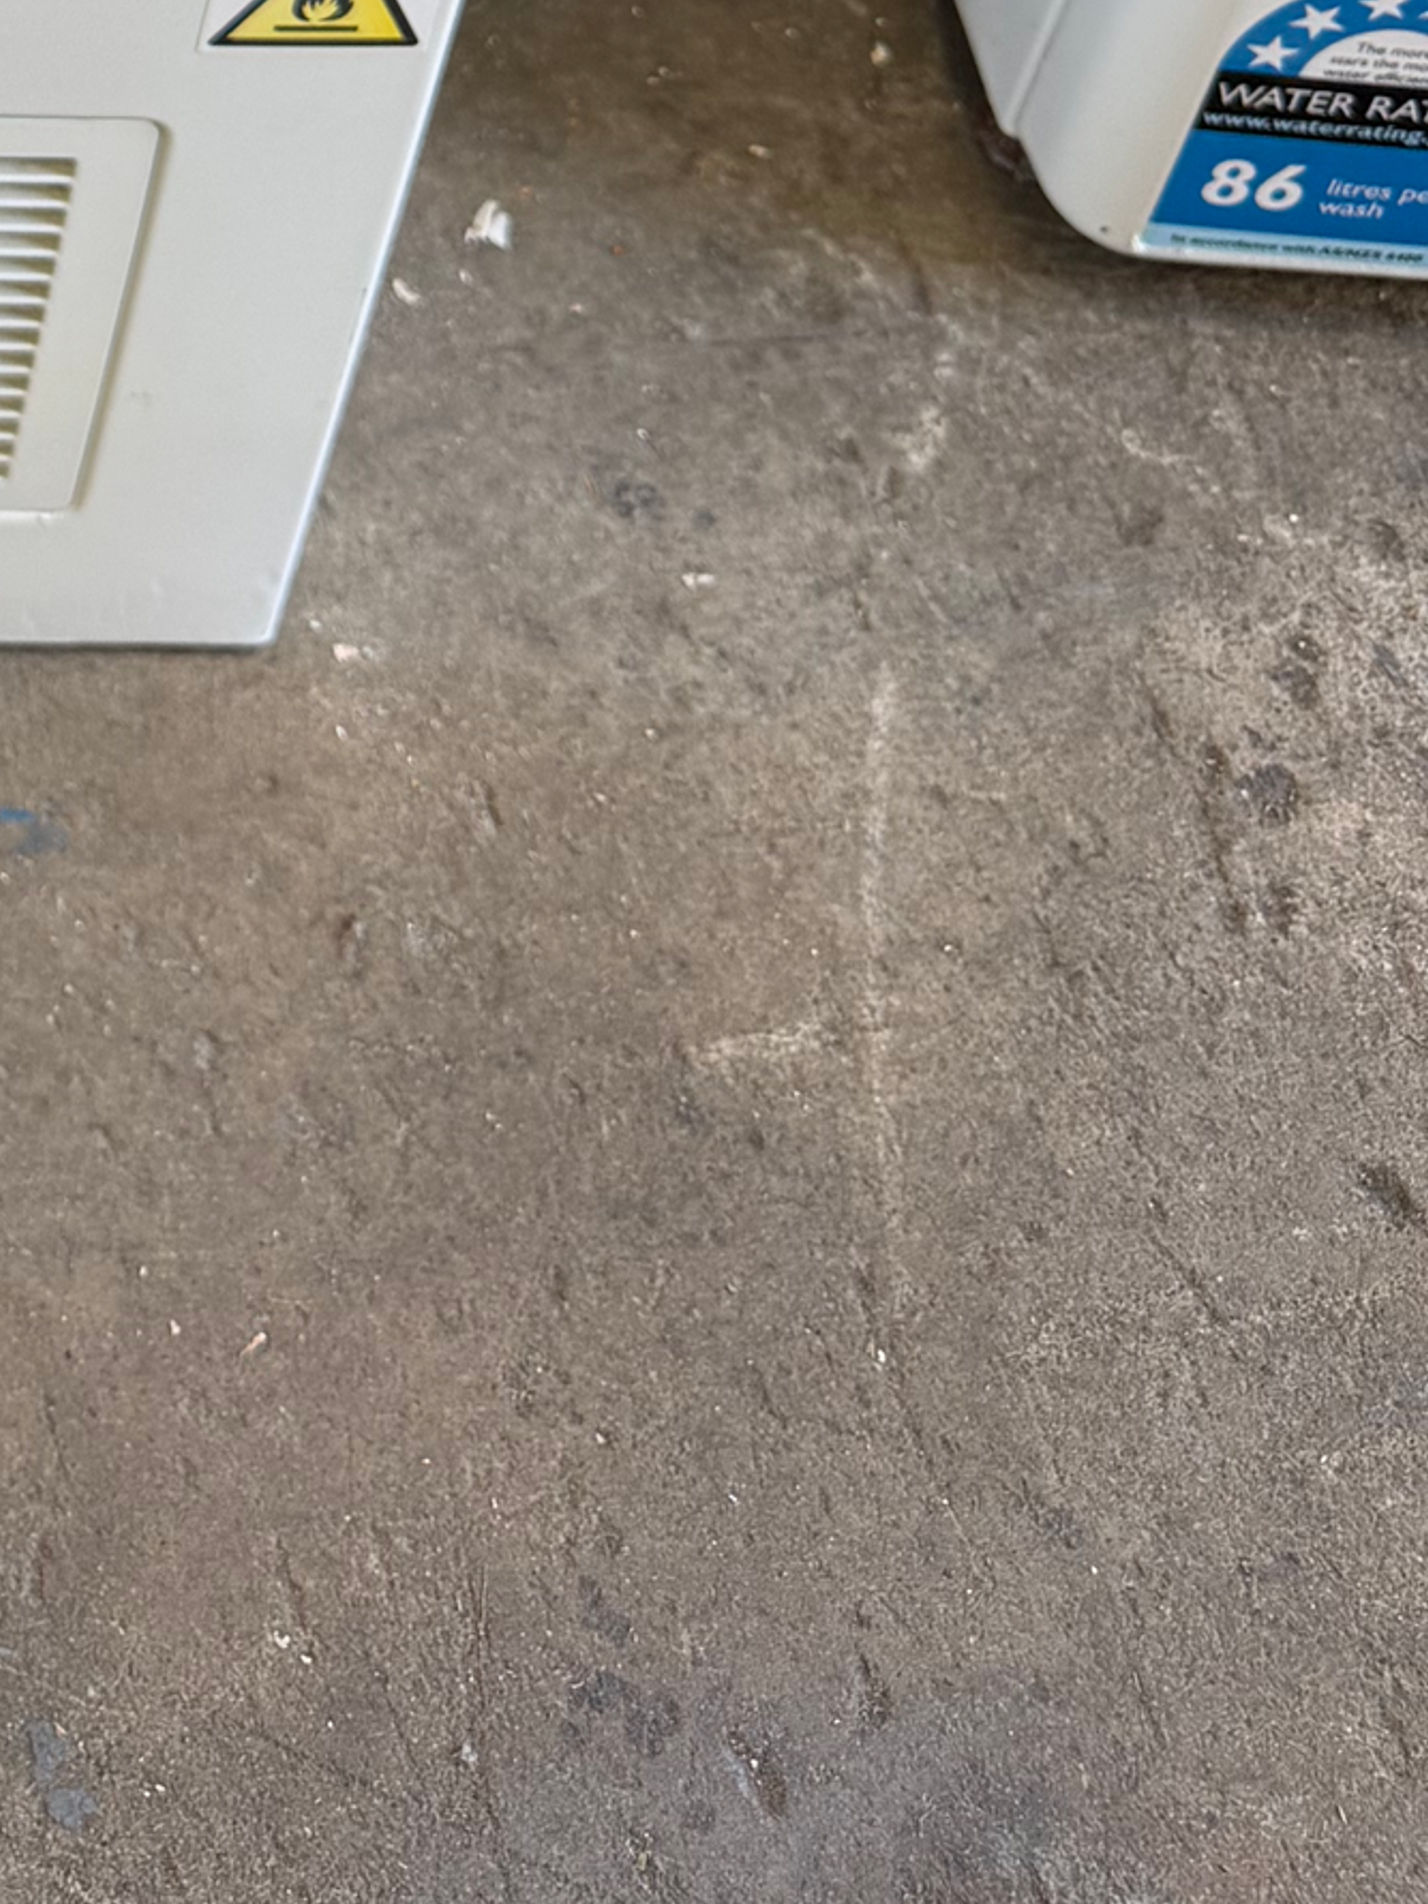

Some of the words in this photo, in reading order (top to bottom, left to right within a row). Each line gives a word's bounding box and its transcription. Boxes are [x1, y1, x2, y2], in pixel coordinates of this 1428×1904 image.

[1218, 80, 1357, 119] WATER
[1200, 157, 1308, 212] 86
[1326, 177, 1392, 202] litres
[1318, 200, 1385, 220] wash
